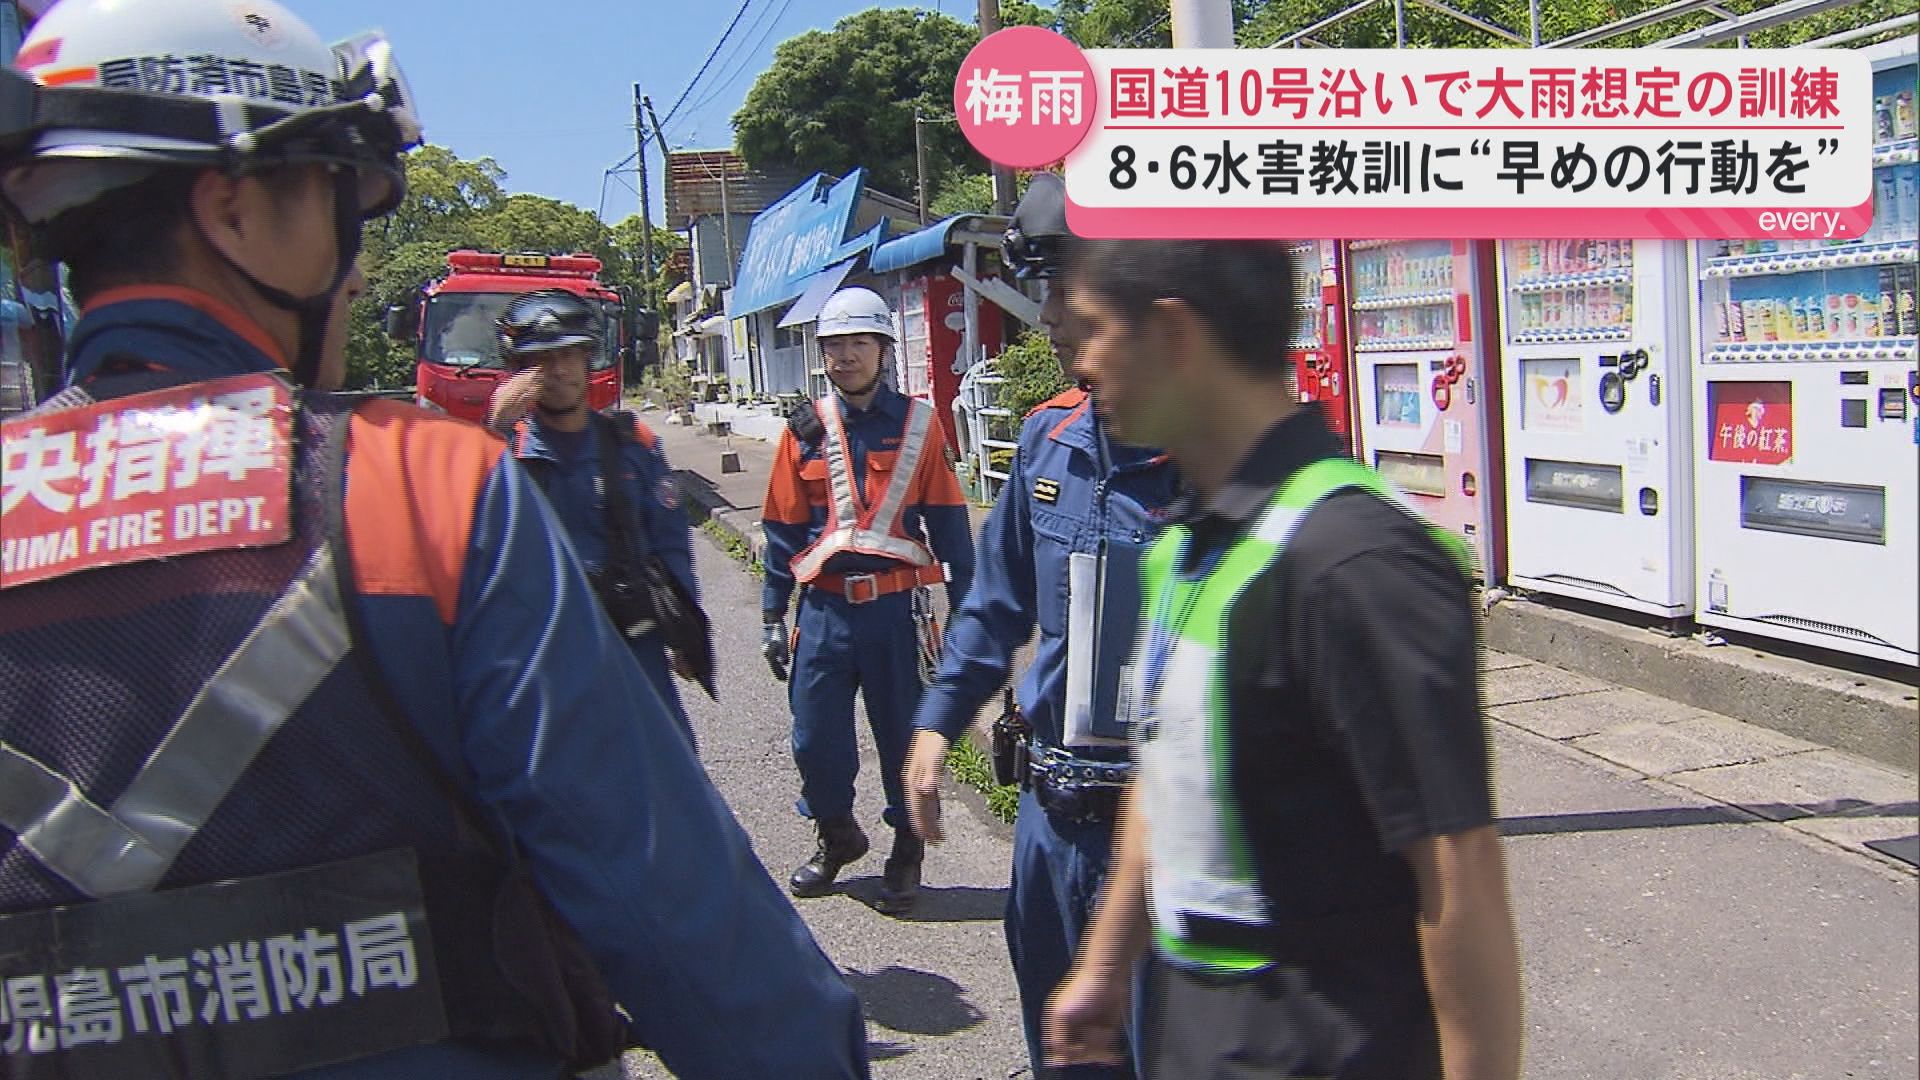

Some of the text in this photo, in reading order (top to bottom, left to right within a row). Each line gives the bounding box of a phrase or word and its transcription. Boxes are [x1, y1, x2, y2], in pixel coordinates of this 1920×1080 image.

[0, 387, 275, 514] 央指揮
[1719, 423, 1788, 453] 午後の紅茶
[88, 509, 165, 553] FIRE
[173, 497, 273, 540] DEPT.
[0, 912, 418, 1054] 児島市消防局
